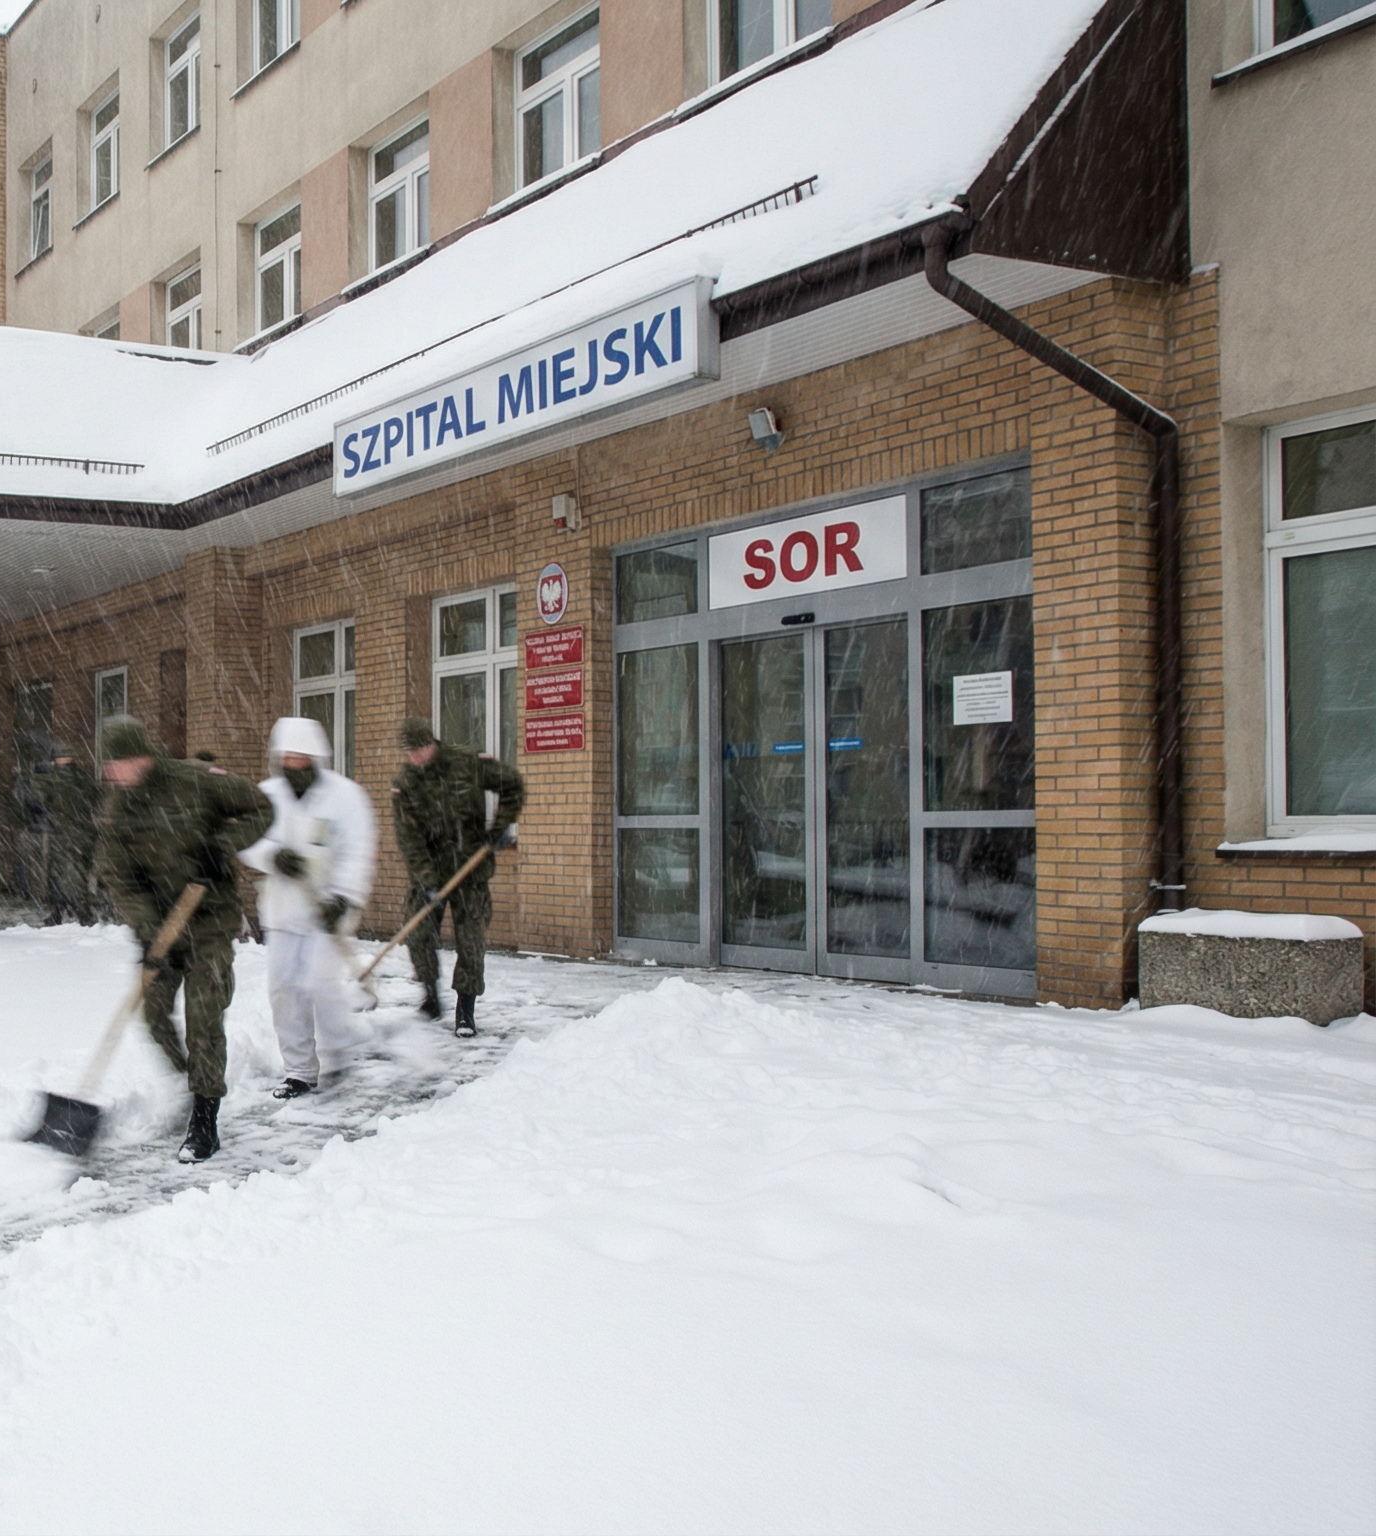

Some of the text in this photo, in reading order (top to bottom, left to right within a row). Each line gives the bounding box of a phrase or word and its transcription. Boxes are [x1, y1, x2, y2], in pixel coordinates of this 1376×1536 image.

[342, 305, 682, 479] SZPITAL MIEJSKI
[743, 521, 864, 590] SOR
